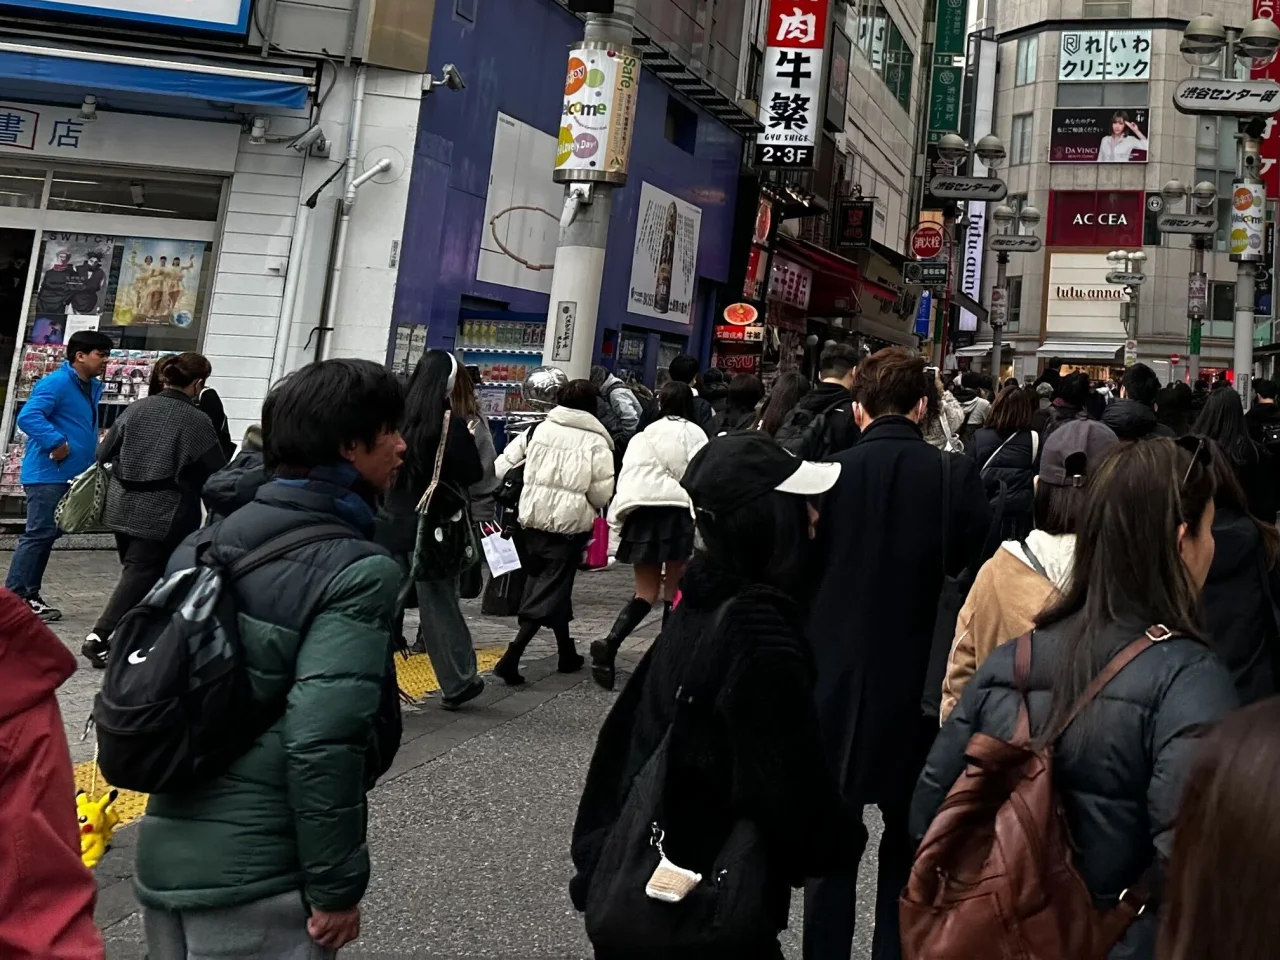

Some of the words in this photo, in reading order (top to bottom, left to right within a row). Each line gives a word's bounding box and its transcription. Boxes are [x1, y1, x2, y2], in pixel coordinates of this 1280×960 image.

[1085, 35, 1149, 54] れいわ
[937, 55, 950, 64] 1F
[1062, 59, 1148, 77] クリニック
[768, 50, 812, 130] 牛繁
[1180, 87, 1279, 102] 渋谷センター街
[764, 133, 781, 141] GYU
[784, 133, 808, 142] SHIGE
[914, 236, 940, 249] 消火栓
